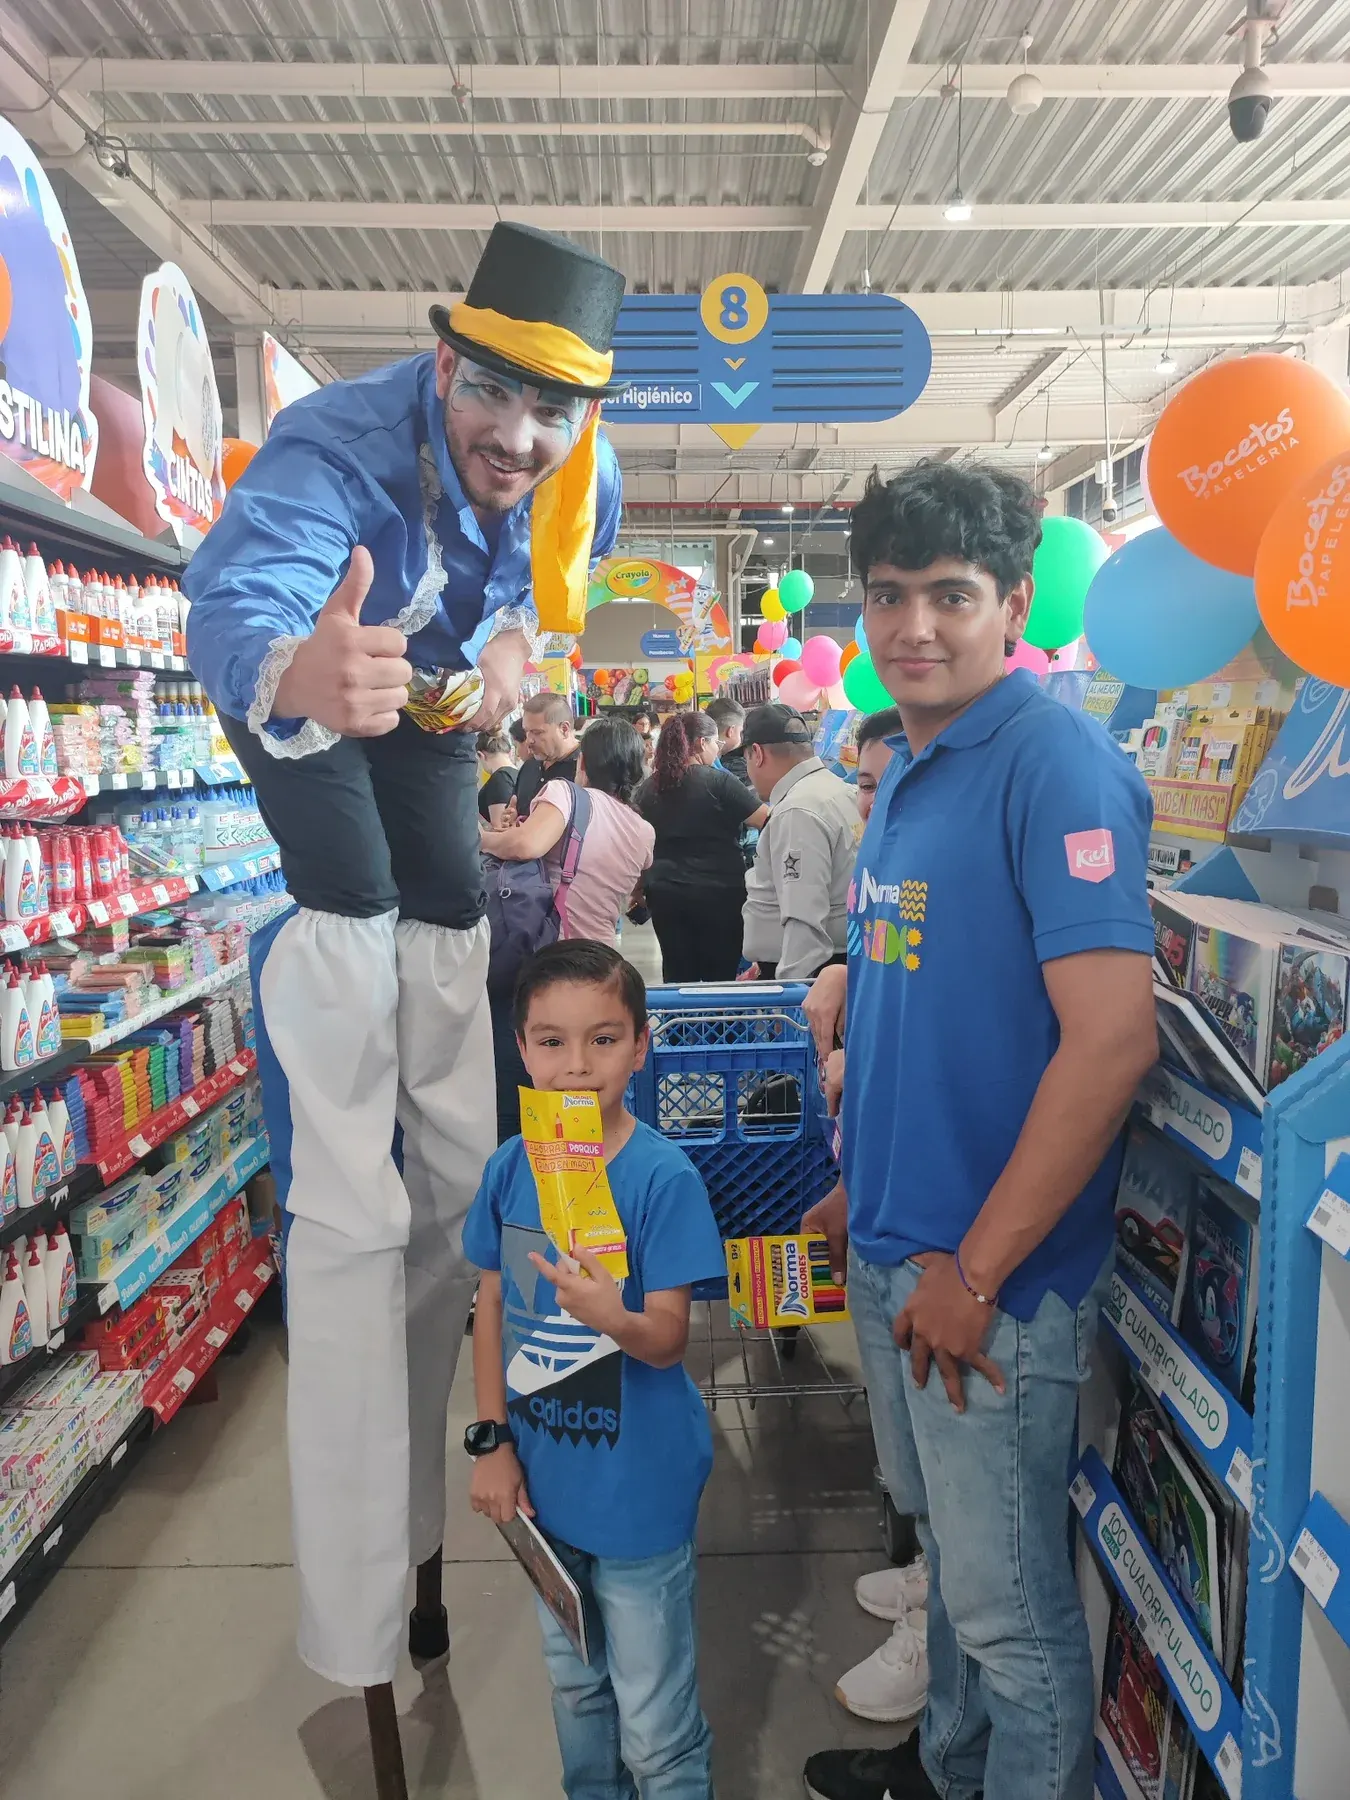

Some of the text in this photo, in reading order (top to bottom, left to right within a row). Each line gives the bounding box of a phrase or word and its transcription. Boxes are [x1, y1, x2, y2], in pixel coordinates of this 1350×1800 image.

[720, 286, 748, 329] 8
[623, 386, 692, 409] Higiénico
[1177, 408, 1294, 497] Bocetos
[1203, 436, 1300, 500] PAPELERÍA
[167, 453, 214, 524] CINTAS
[1286, 464, 1350, 611] Bocetos
[615, 570, 650, 580] Crayola
[564, 1096, 594, 1108] Norma
[568, 1143, 600, 1155] PORQUE
[781, 1243, 808, 1316] Norma
[798, 1254, 809, 1299] COLORES
[1111, 1280, 1220, 1431] 100 CUADRICULADO
[529, 1396, 617, 1432] adidas
[1109, 1512, 1213, 1713] 100 CUADRICULADO
